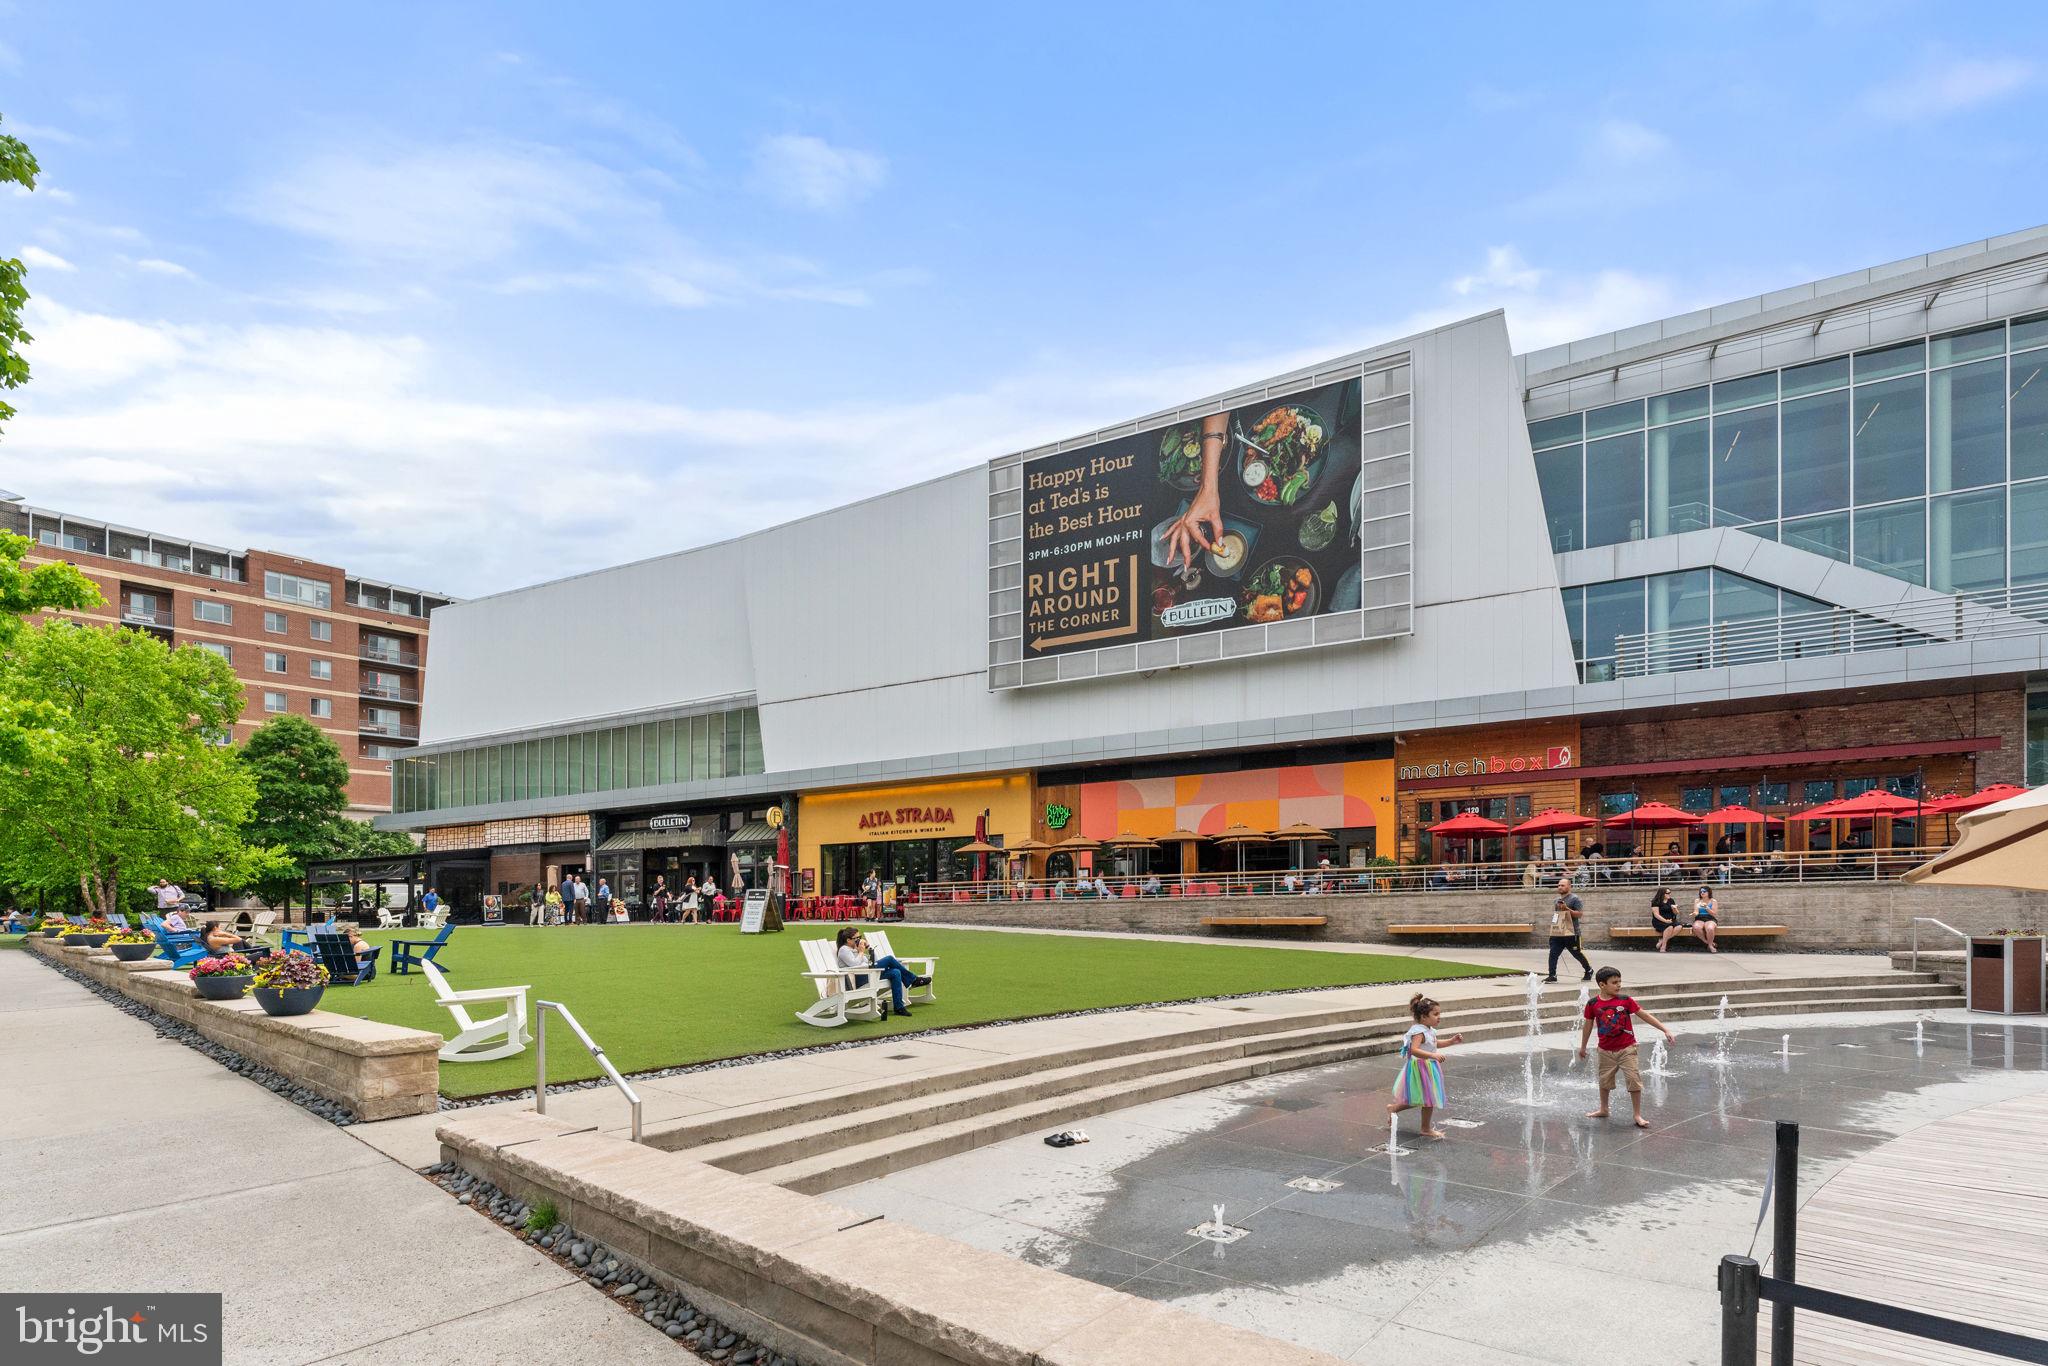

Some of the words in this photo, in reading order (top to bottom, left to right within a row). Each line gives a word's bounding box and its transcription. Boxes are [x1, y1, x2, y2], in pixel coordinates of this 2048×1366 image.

[1029, 466, 1085, 491] Happy
[1090, 454, 1135, 476] Hour
[1028, 498, 1045, 515] at
[1049, 487, 1091, 510] Ted's
[1095, 483, 1110, 500] is
[1028, 522, 1054, 539] the
[1058, 512, 1093, 533] Best
[1097, 504, 1143, 525] Hour
[1028, 540, 1092, 561] 3PM-6:30PM
[1096, 529, 1143, 548] MON-FRI
[1028, 557, 1120, 598] RIGHT
[1029, 586, 1120, 618] AROUND
[1169, 603, 1228, 622] BULLETIN
[1028, 619, 1055, 634] THE
[1059, 608, 1120, 629] CORNER
[1400, 755, 1543, 780] matchbox
[653, 817, 686, 828] BULLETIN
[859, 809, 894, 829] ALTA
[895, 806, 955, 824] STRADA
[1046, 803, 1069, 819] Kirby
[1047, 815, 1066, 826] Club
